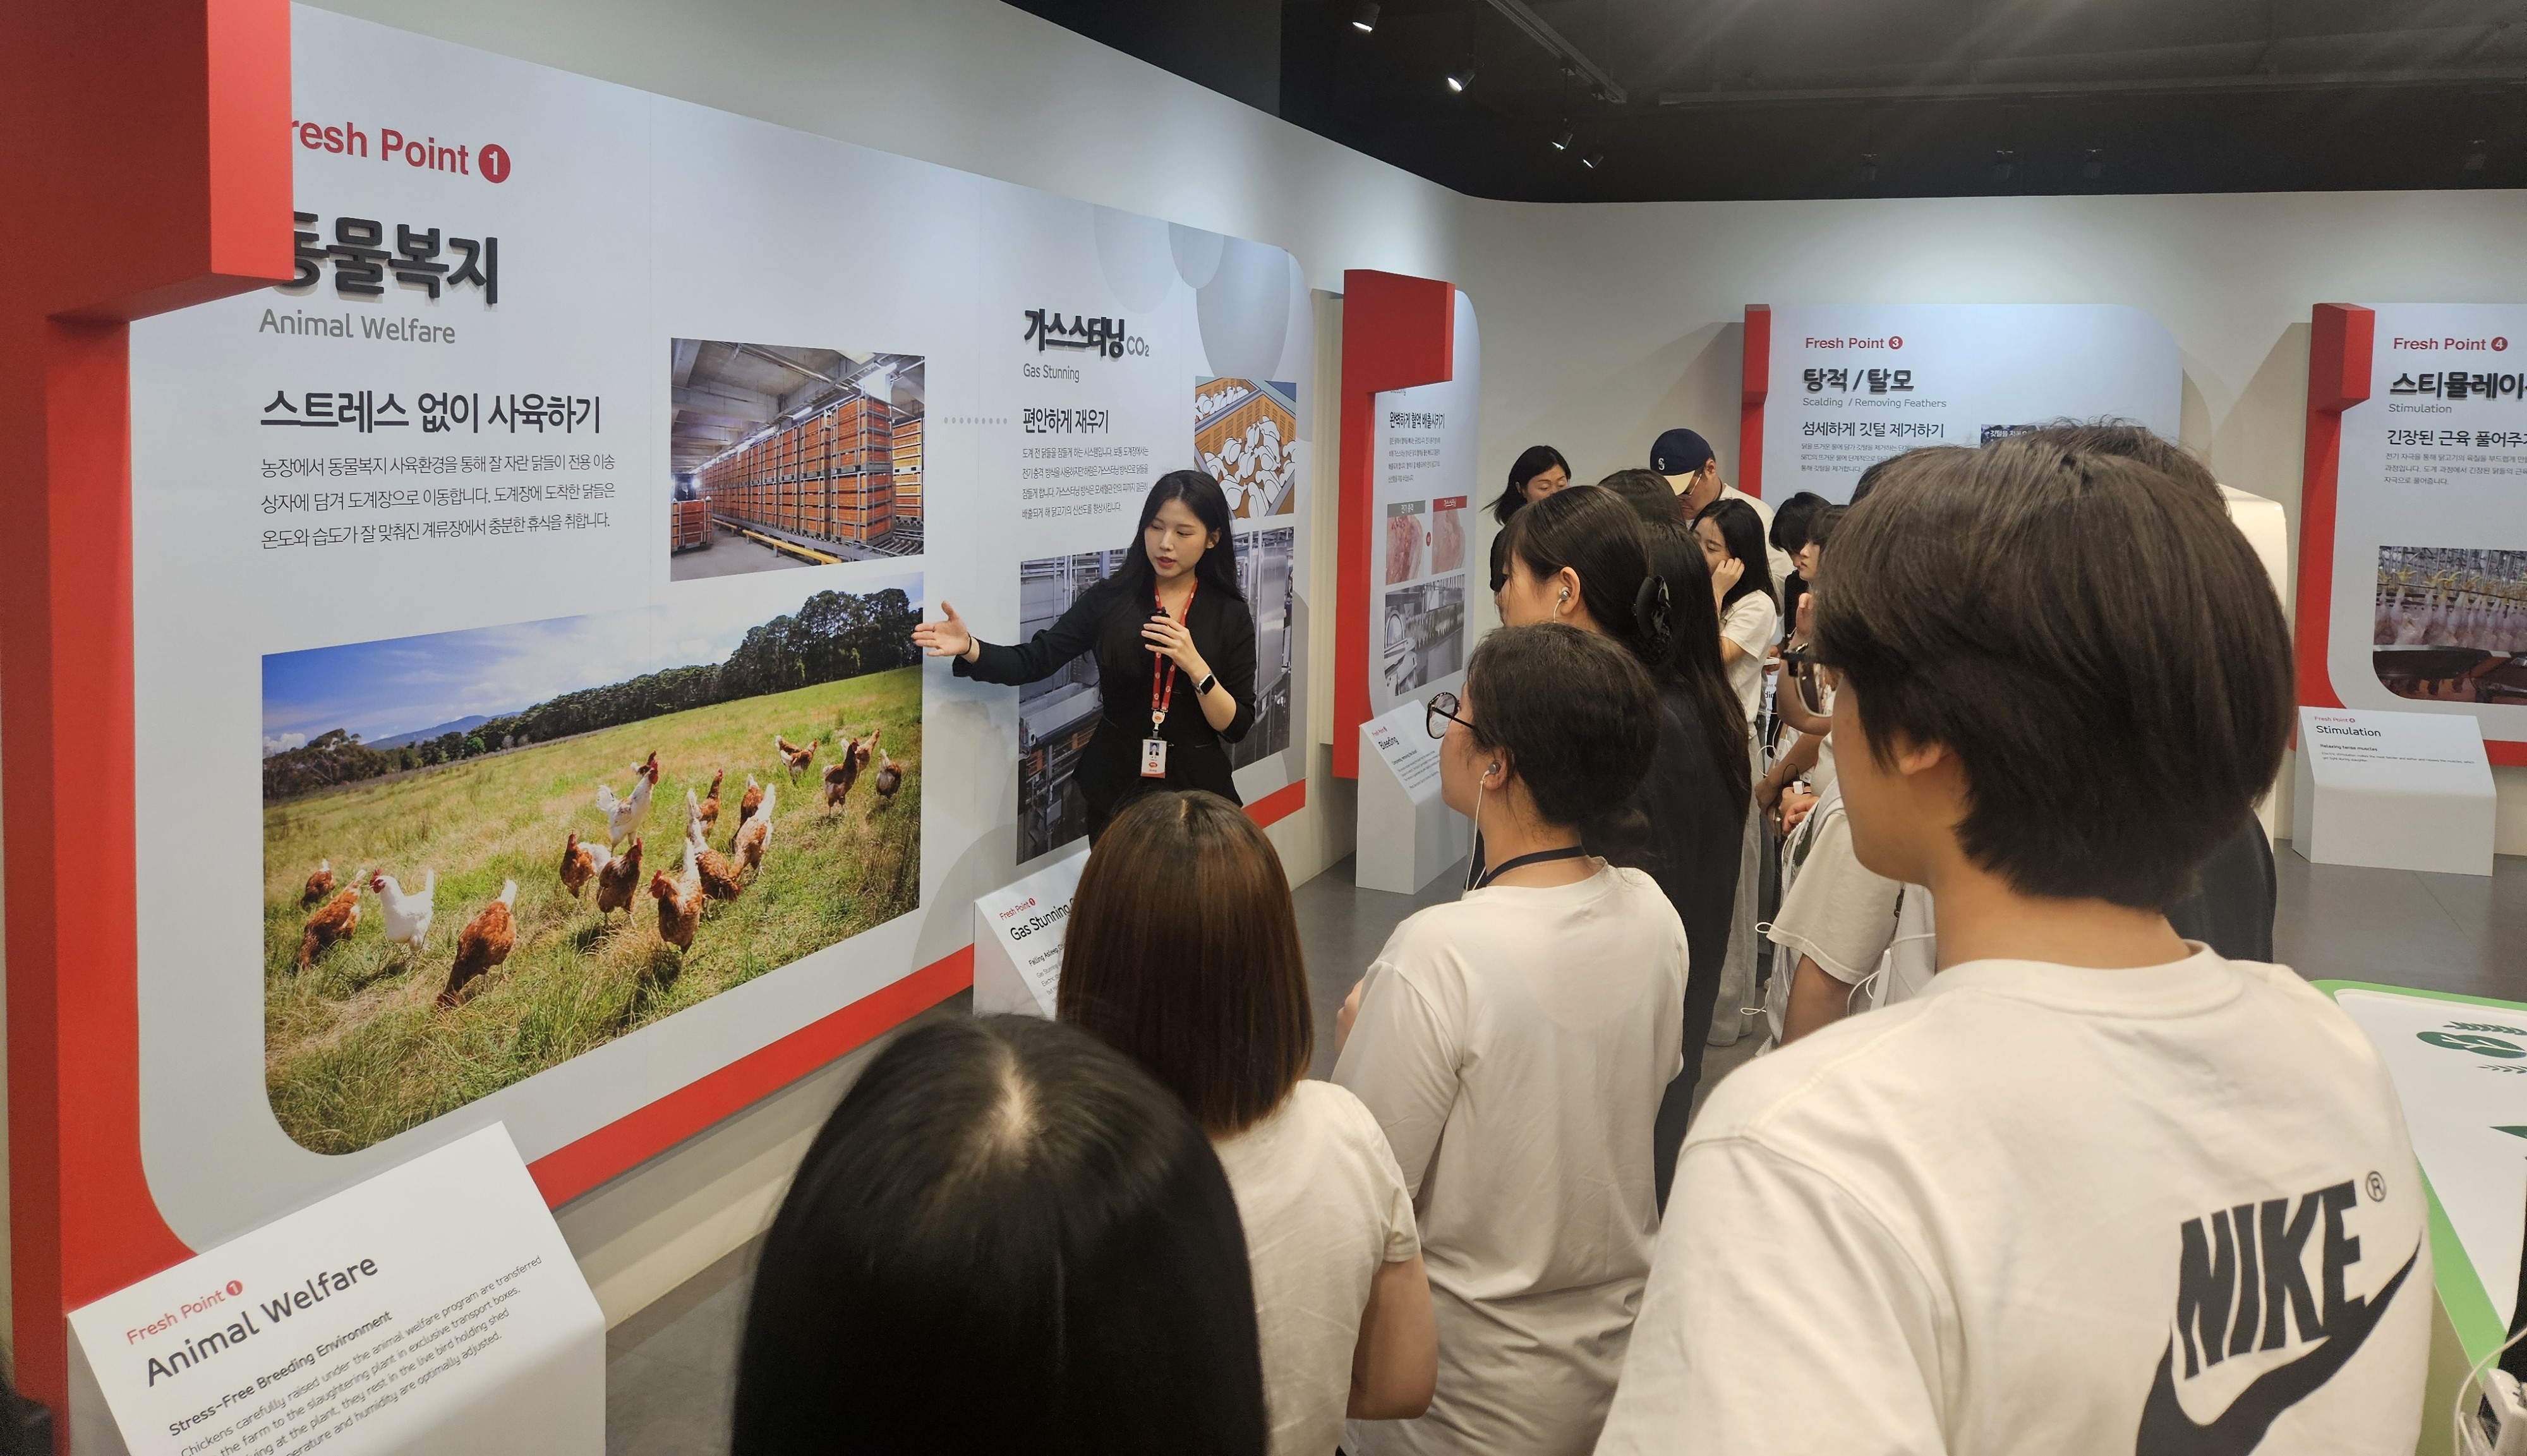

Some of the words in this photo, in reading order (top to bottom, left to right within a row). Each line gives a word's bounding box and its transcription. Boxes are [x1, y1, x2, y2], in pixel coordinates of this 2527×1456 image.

[382, 128, 469, 175] Point
[259, 308, 354, 339] Animal
[361, 315, 455, 344] Welfare
[1024, 308, 1125, 358] 가스스터닝
[1805, 337, 1844, 349] Fresh
[1849, 337, 1884, 349] Point
[2393, 337, 2439, 350] Fresh
[2444, 338, 2486, 351] Point
[1023, 363, 1040, 378] Gas
[1043, 364, 1080, 383] Stunning
[1803, 368, 1849, 392] 탕적
[1868, 368, 1915, 394] 탈모
[2390, 372, 2527, 399] 스티뮬레이
[260, 390, 409, 433] 스트레스
[418, 392, 478, 433] 없이
[488, 394, 600, 434] 사육하기
[1802, 397, 1843, 407] Scalding
[1855, 398, 1902, 409] Removing
[1904, 399, 1947, 408] Feathers
[2388, 404, 2452, 414] Stimulation
[1023, 407, 1072, 434] 편안하게
[1075, 409, 1109, 434] 재우기
[1389, 411, 1410, 429] 완벽하게
[1422, 412, 1445, 429] 배출시키기
[1802, 421, 1855, 437] 섬세하게
[1859, 421, 1886, 437] 깃털
[1890, 422, 1945, 438] 제거하기
[2387, 430, 2434, 445] 긴장된
[2439, 431, 2471, 447] 근육
[261, 458, 324, 478] 농장에서
[328, 457, 387, 476] 동물복지
[390, 456, 457, 474] 사육환경을
[460, 456, 486, 473] 통해
[489, 455, 502, 472] 잘
[504, 455, 529, 471] 자란
[532, 454, 565, 471] 닭들이
[569, 454, 591, 470] 전용
[594, 454, 615, 470] 이송
[1034, 448, 1040, 459] 전
[261, 493, 309, 514] 상자에
[314, 492, 344, 512] 담겨
[348, 490, 420, 508] 도계장으로
[423, 487, 490, 506] 이동합니다.
[494, 485, 542, 502] 도계장에
[545, 484, 579, 500] 도착한
[582, 483, 615, 499] 닭들은
[262, 528, 310, 550] 온도와
[312, 526, 358, 546] 습도가
[361, 524, 376, 543] 잘
[378, 522, 419, 542] 맞춰진
[422, 519, 486, 538] 계류장에서
[488, 516, 526, 534] 충분한
[527, 514, 562, 532] 휴식을
[564, 512, 610, 529] 취합니다.
[2316, 725, 2381, 737] Stimulation
[999, 908, 1017, 920] Fresh
[1015, 901, 1031, 913] Point
[1010, 925, 1032, 941] Gas
[1028, 955, 1045, 966] Falling
[1044, 948, 1059, 959] Asleep
[2176, 1179, 2366, 1381] NIKE
[126, 1313, 178, 1345] Fresh
[180, 1290, 226, 1319] Point
[148, 1311, 260, 1388] Animal
[260, 1255, 379, 1323] Welfare
[181, 1425, 234, 1456] Chickens
[236, 1397, 287, 1430] carefully
[287, 1376, 321, 1402] raised
[321, 1361, 351, 1383] under
[352, 1351, 371, 1365] the
[371, 1330, 405, 1356] animal
[405, 1312, 441, 1337] welfare
[442, 1291, 479, 1319] program
[479, 1282, 495, 1296] are
[495, 1254, 542, 1287] transferred
[256, 1352, 316, 1390] Breeding
[316, 1311, 393, 1358] Environment
[242, 1424, 271, 1447] farm
[271, 1417, 285, 1429] to
[286, 1406, 306, 1422] the
[307, 1370, 371, 1411] slaughtering
[371, 1354, 397, 1376] plant
[397, 1348, 407, 1359] in
[409, 1324, 451, 1354] exclusive
[451, 1301, 493, 1328] transport
[493, 1286, 521, 1306] boxes.
[276, 1435, 289, 1448] at
[289, 1423, 308, 1440] the
[310, 1406, 341, 1430] plant,
[341, 1390, 366, 1410] they
[366, 1377, 388, 1396] rest
[387, 1372, 399, 1383] in
[399, 1362, 417, 1376] the
[416, 1351, 435, 1366] live
[435, 1339, 455, 1356] bird
[454, 1321, 489, 1345] holding
[488, 1307, 510, 1326] shed
[334, 1416, 354, 1435] and
[353, 1391, 399, 1422] humidity
[399, 1381, 417, 1396] are
[416, 1352, 461, 1386] optimally
[462, 1330, 503, 1360] adjusted.
